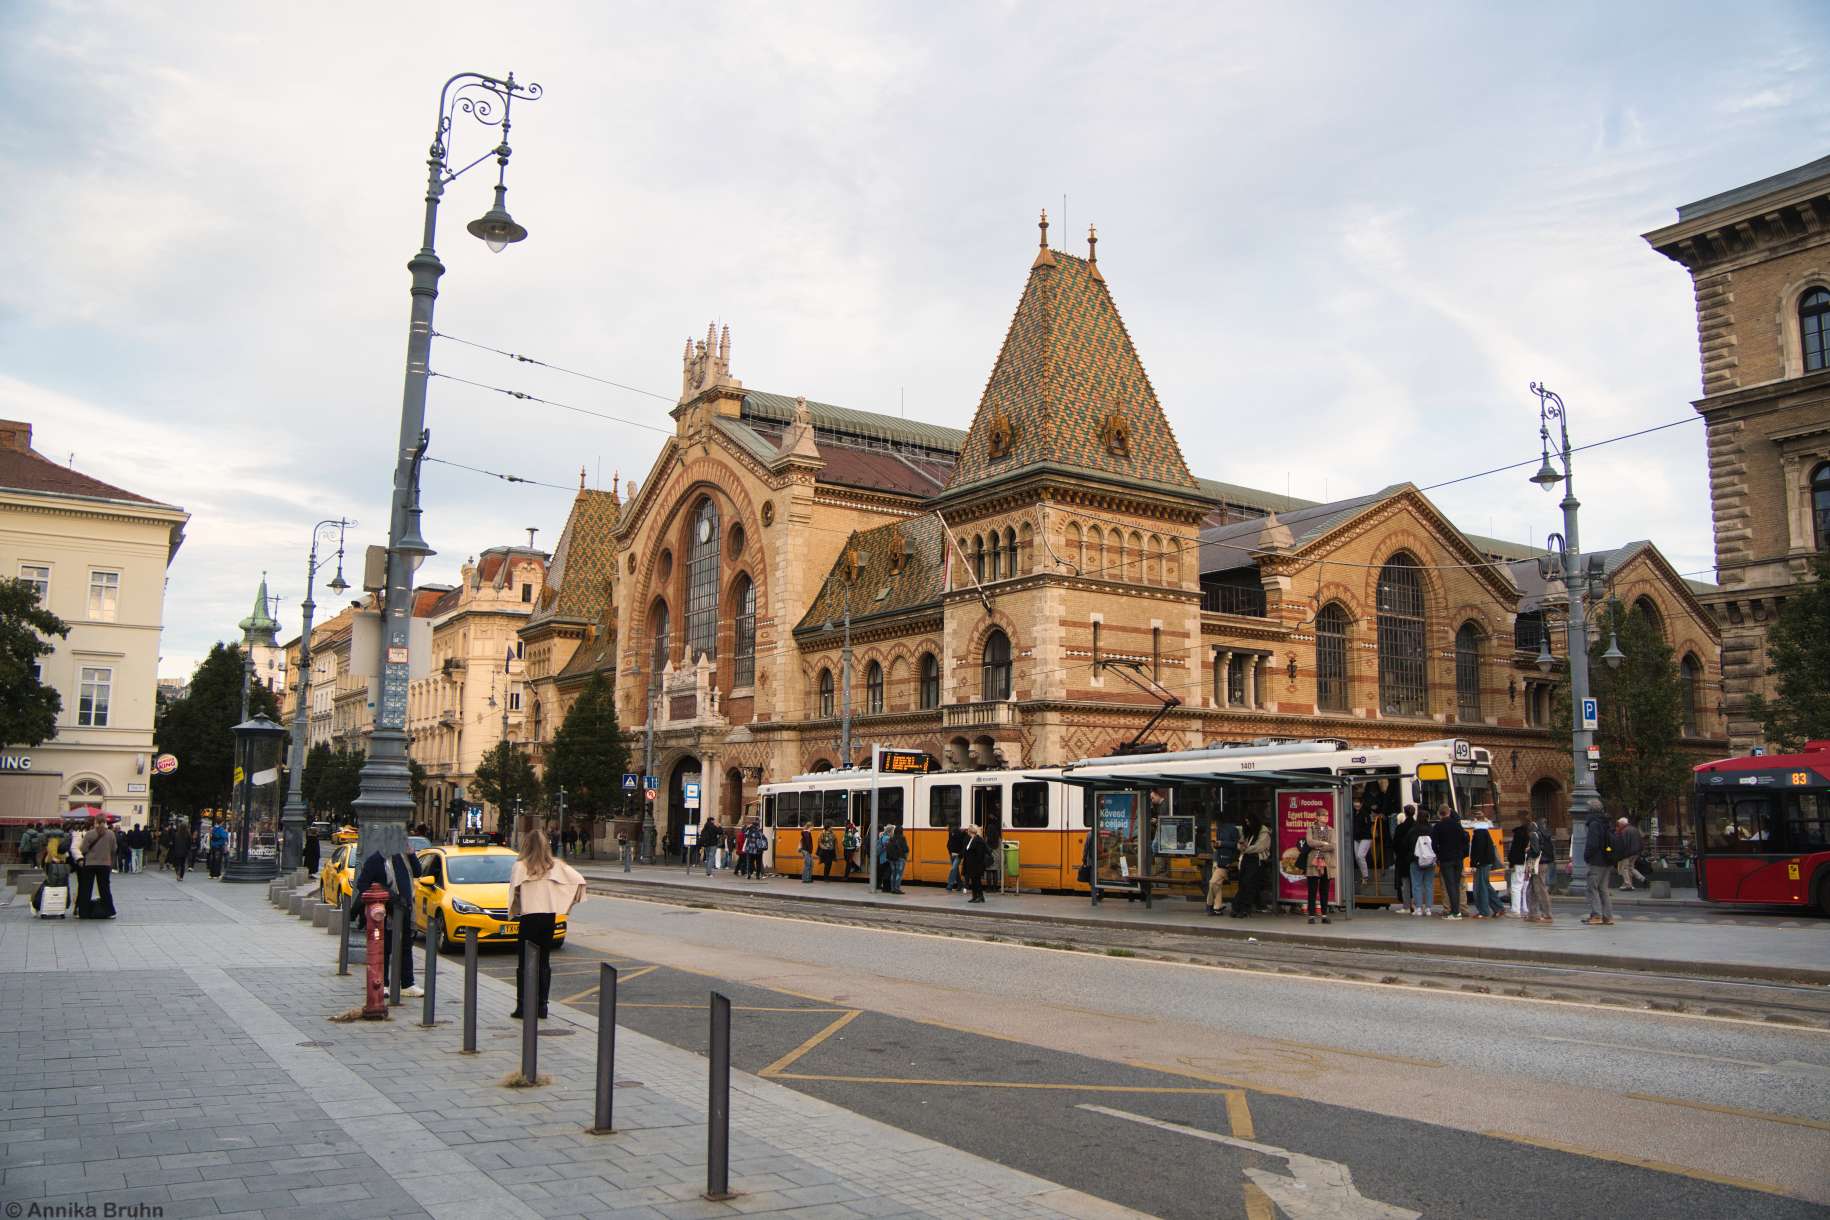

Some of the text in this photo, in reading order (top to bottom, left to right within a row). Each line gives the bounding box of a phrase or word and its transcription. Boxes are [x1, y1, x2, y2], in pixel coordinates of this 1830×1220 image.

[1586, 703, 1593, 718] P
[1457, 744, 1468, 757] 49
[1, 756, 31, 769] ING
[159, 761, 176, 769] KING
[1792, 773, 1807, 785] 83
